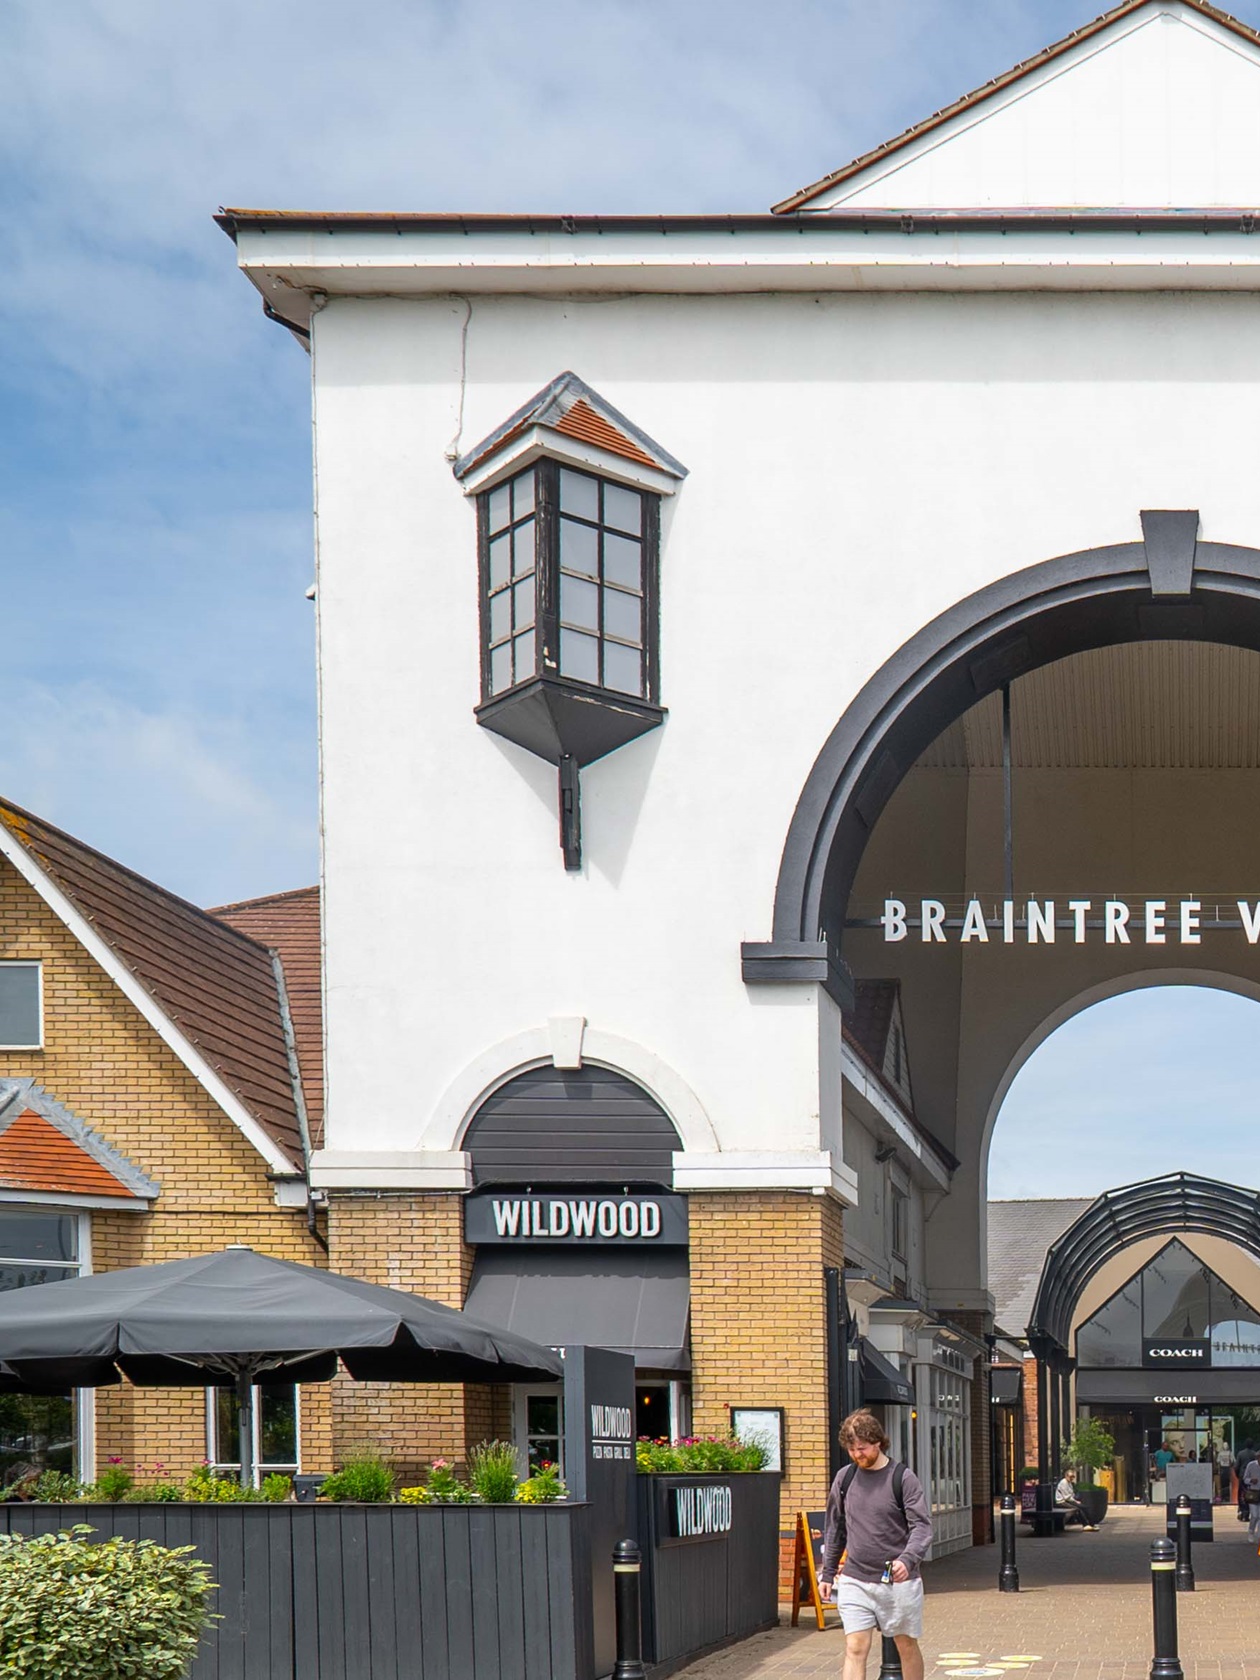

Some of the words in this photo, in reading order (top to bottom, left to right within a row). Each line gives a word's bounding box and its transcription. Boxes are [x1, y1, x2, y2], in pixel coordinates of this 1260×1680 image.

[881, 899, 1202, 943] BRAINTREE
[492, 1200, 662, 1238] WILDWOOD
[1149, 1349, 1203, 1357] COACH
[591, 1404, 632, 1439] WILDWOOD
[676, 1486, 732, 1537] WILDWOOD
